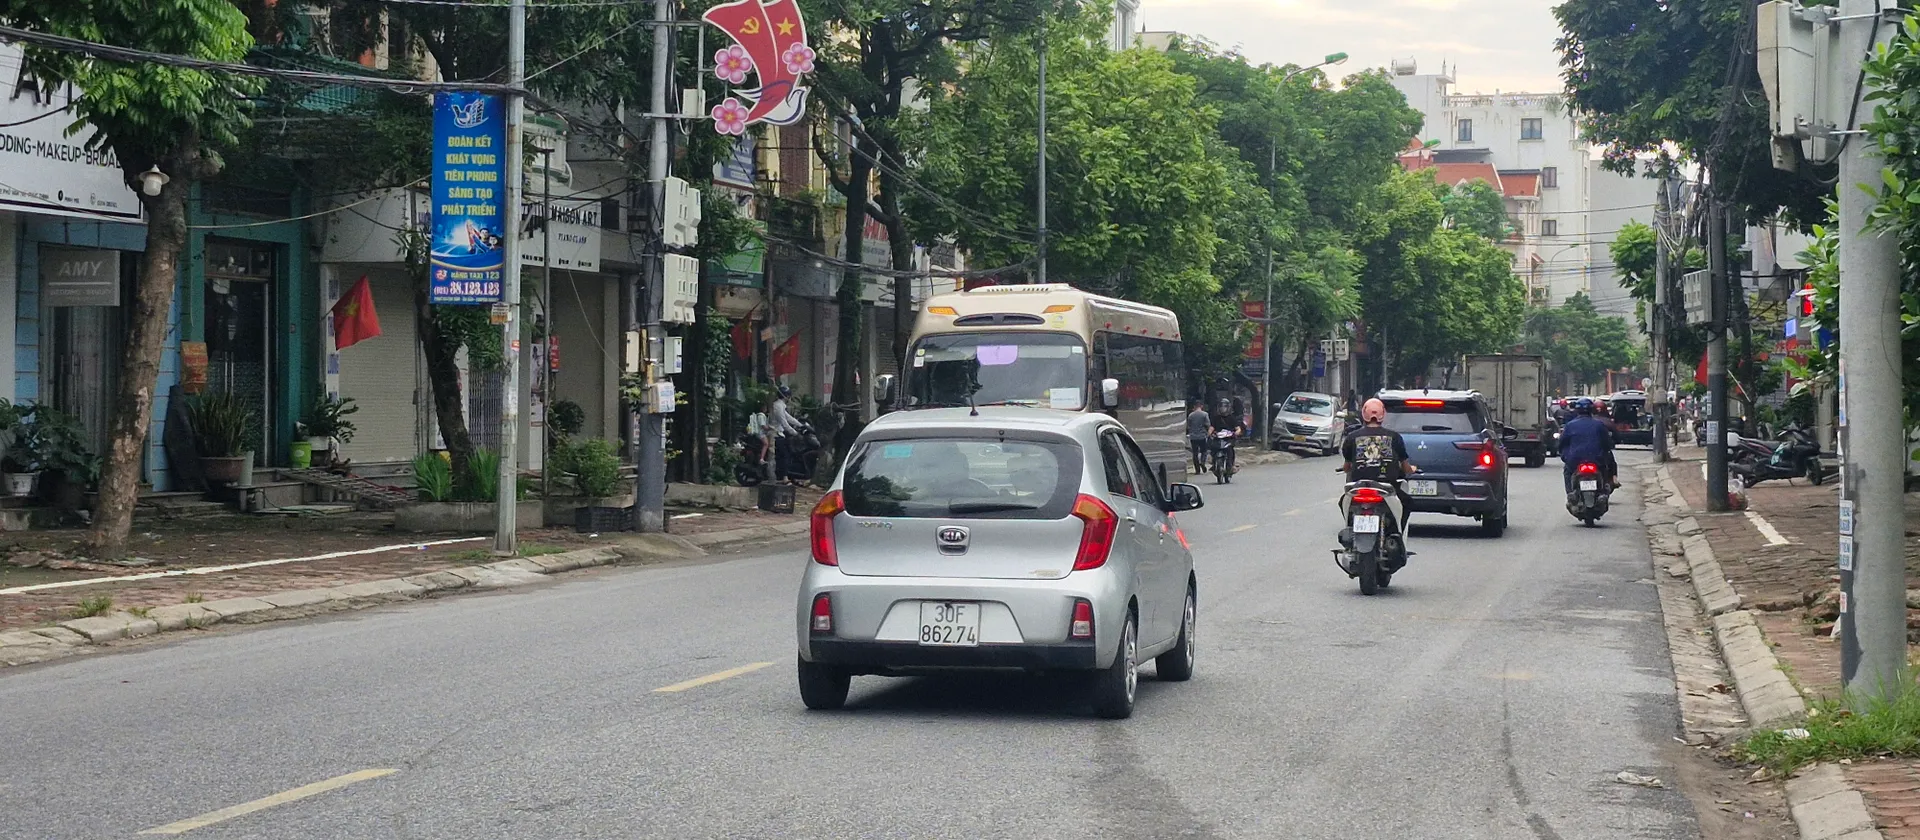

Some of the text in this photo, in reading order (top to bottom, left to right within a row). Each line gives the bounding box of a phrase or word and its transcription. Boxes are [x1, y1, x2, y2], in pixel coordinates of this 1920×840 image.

[475, 134, 492, 147] KẾT
[446, 152, 496, 166] KHÁT VỌNG
[444, 169, 497, 182] TIÊN PHONG
[448, 186, 493, 200] SÁNG TẠO
[441, 202, 464, 215] PHÁT
[552, 205, 580, 224] MAISON
[582, 210, 597, 227] ART
[59, 261, 103, 276] AMY
[486, 271, 500, 280] 123
[450, 281, 500, 296] 38.123.123
[943, 531, 962, 540] KIA
[935, 605, 965, 623] 30F
[921, 624, 976, 644] 862.74
